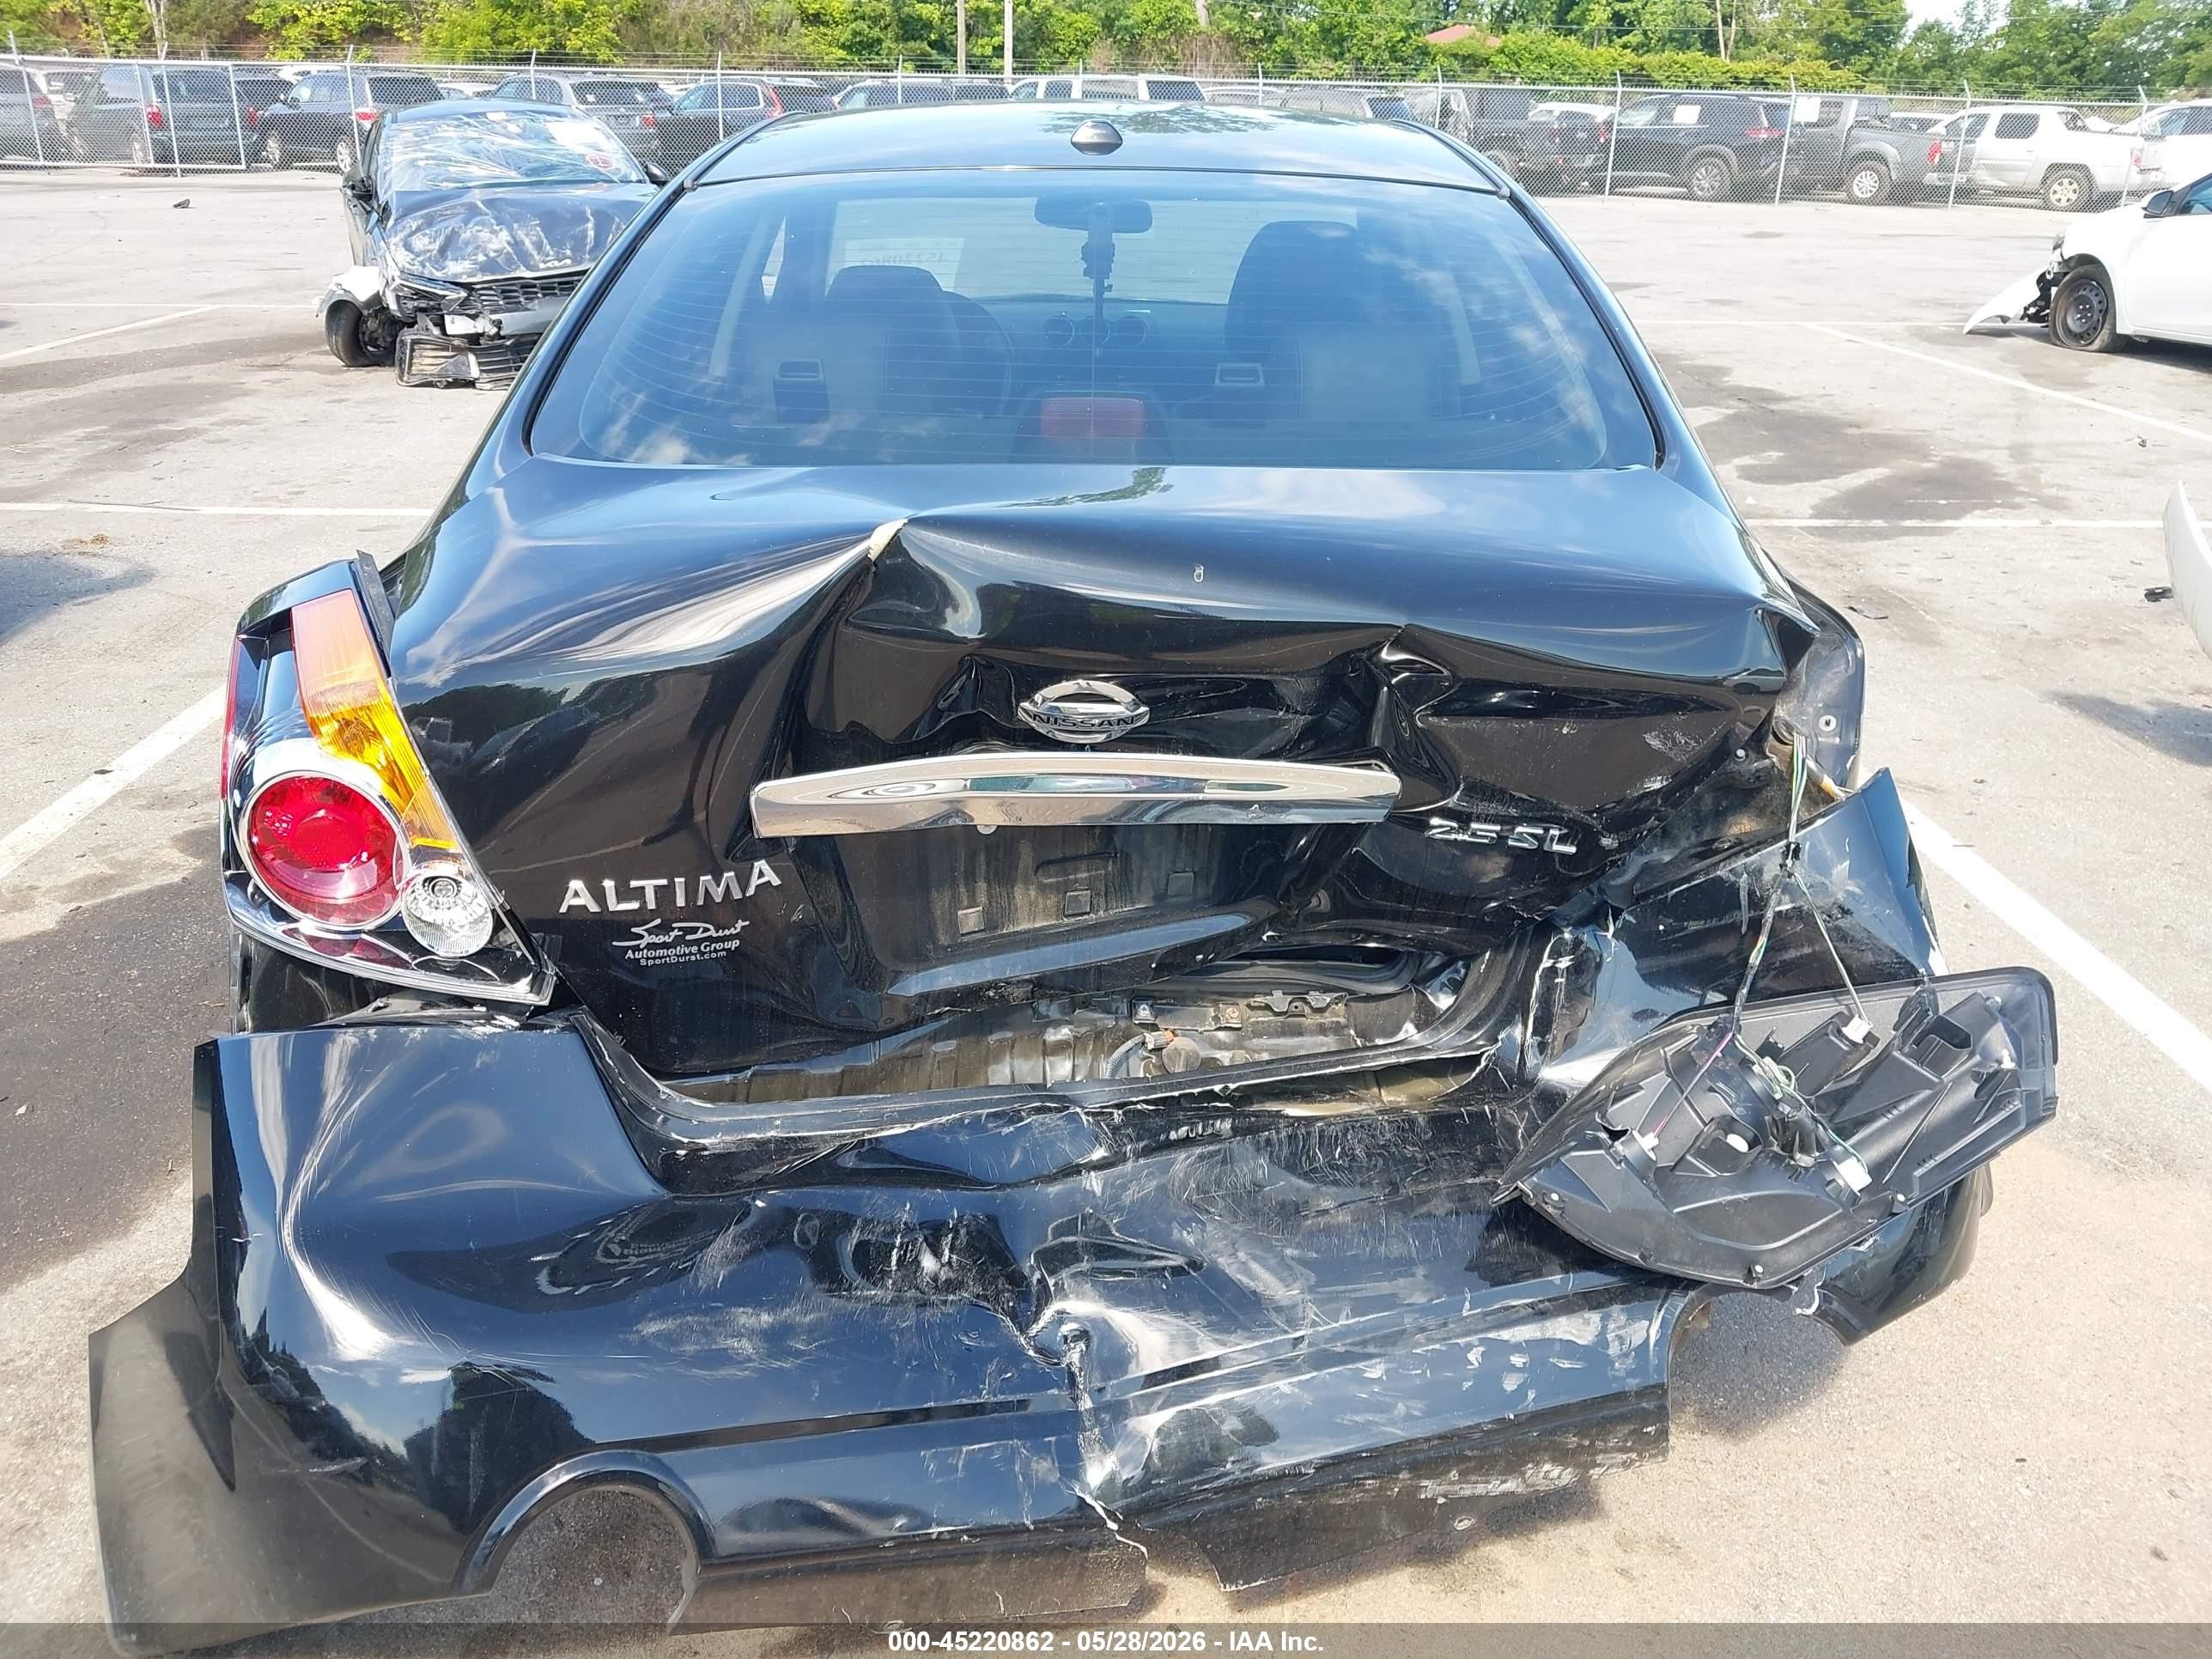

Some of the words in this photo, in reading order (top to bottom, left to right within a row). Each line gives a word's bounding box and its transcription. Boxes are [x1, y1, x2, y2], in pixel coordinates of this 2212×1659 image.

[1031, 714, 1136, 728] NISSAN
[1507, 825, 1578, 855] SL
[558, 859, 781, 914] ALTIMA
[611, 918, 683, 948] Sport
[624, 944, 699, 960] Automotive
[700, 939, 740, 956] Group
[639, 950, 727, 967] SportDurst.com
